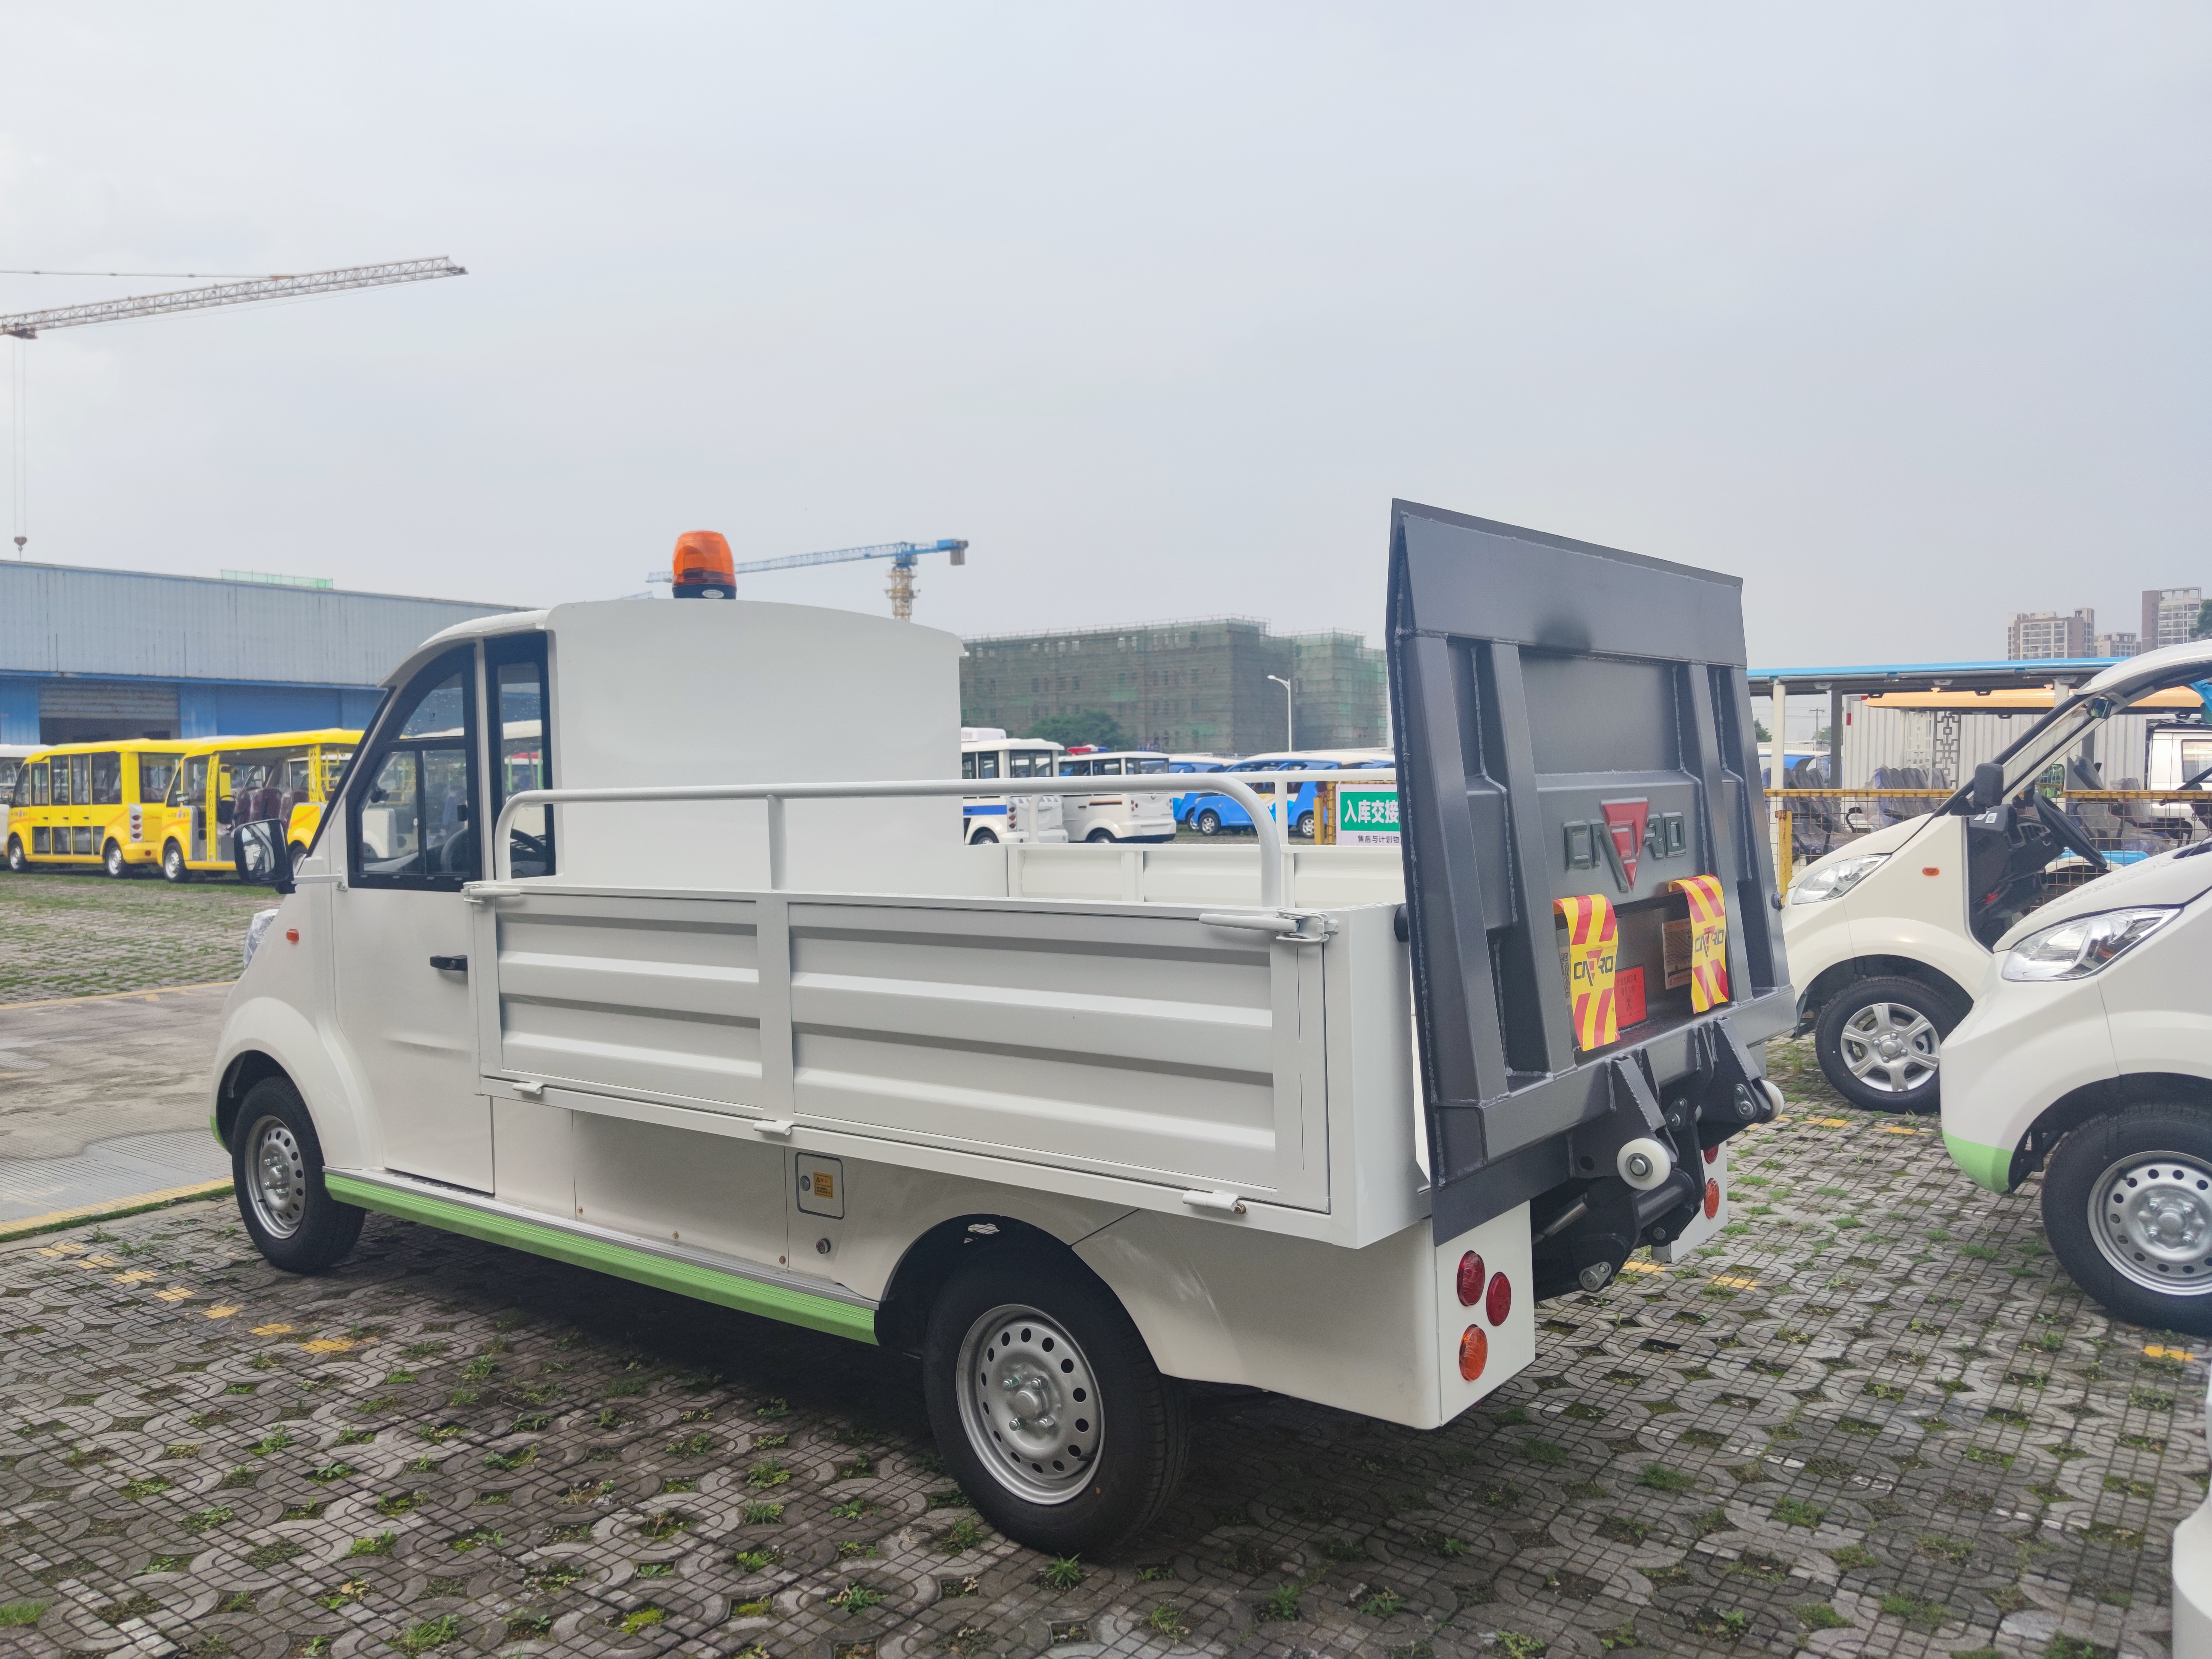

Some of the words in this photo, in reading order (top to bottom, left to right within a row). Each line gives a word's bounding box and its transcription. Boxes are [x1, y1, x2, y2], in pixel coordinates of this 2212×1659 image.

[1344, 799, 1399, 824] 入库交接
[1358, 835, 1401, 843] 售后与计划物
